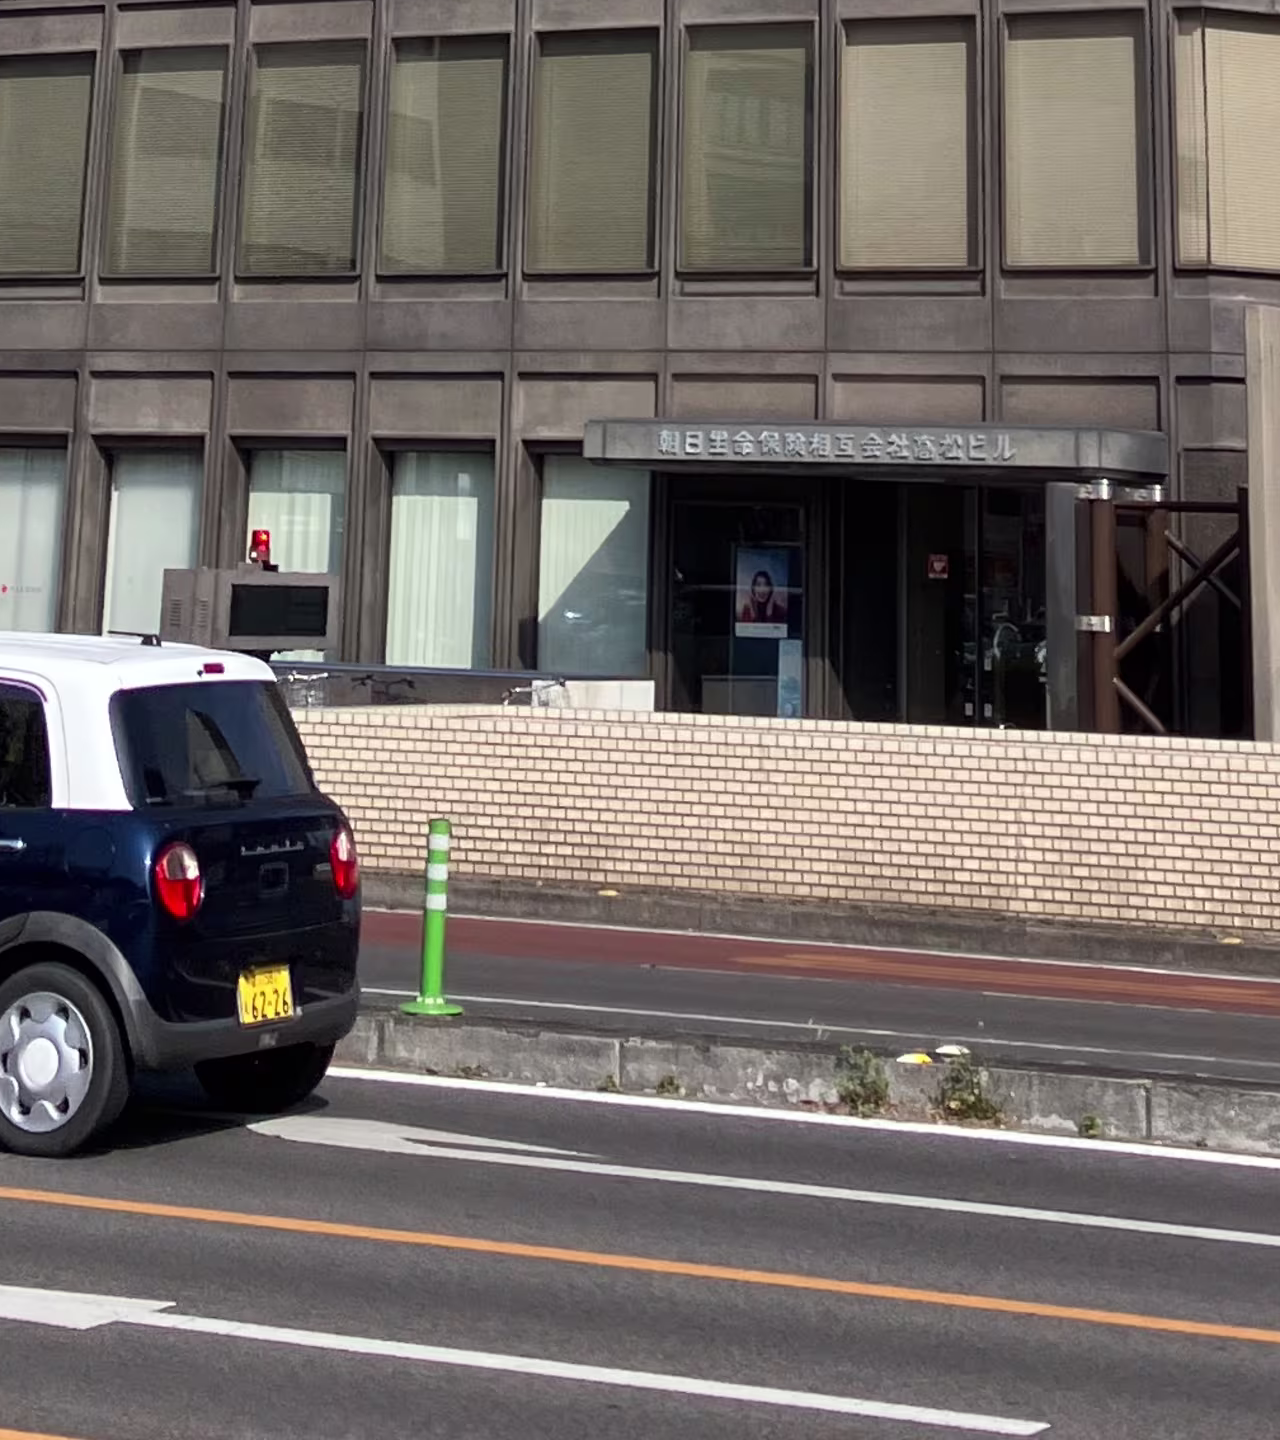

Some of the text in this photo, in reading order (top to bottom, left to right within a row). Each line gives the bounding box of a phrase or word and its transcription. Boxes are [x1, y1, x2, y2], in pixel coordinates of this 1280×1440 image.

[657, 429, 1018, 461] 朝日生命保険相互会社高松ビル
[251, 987, 289, 1020] 62-26
